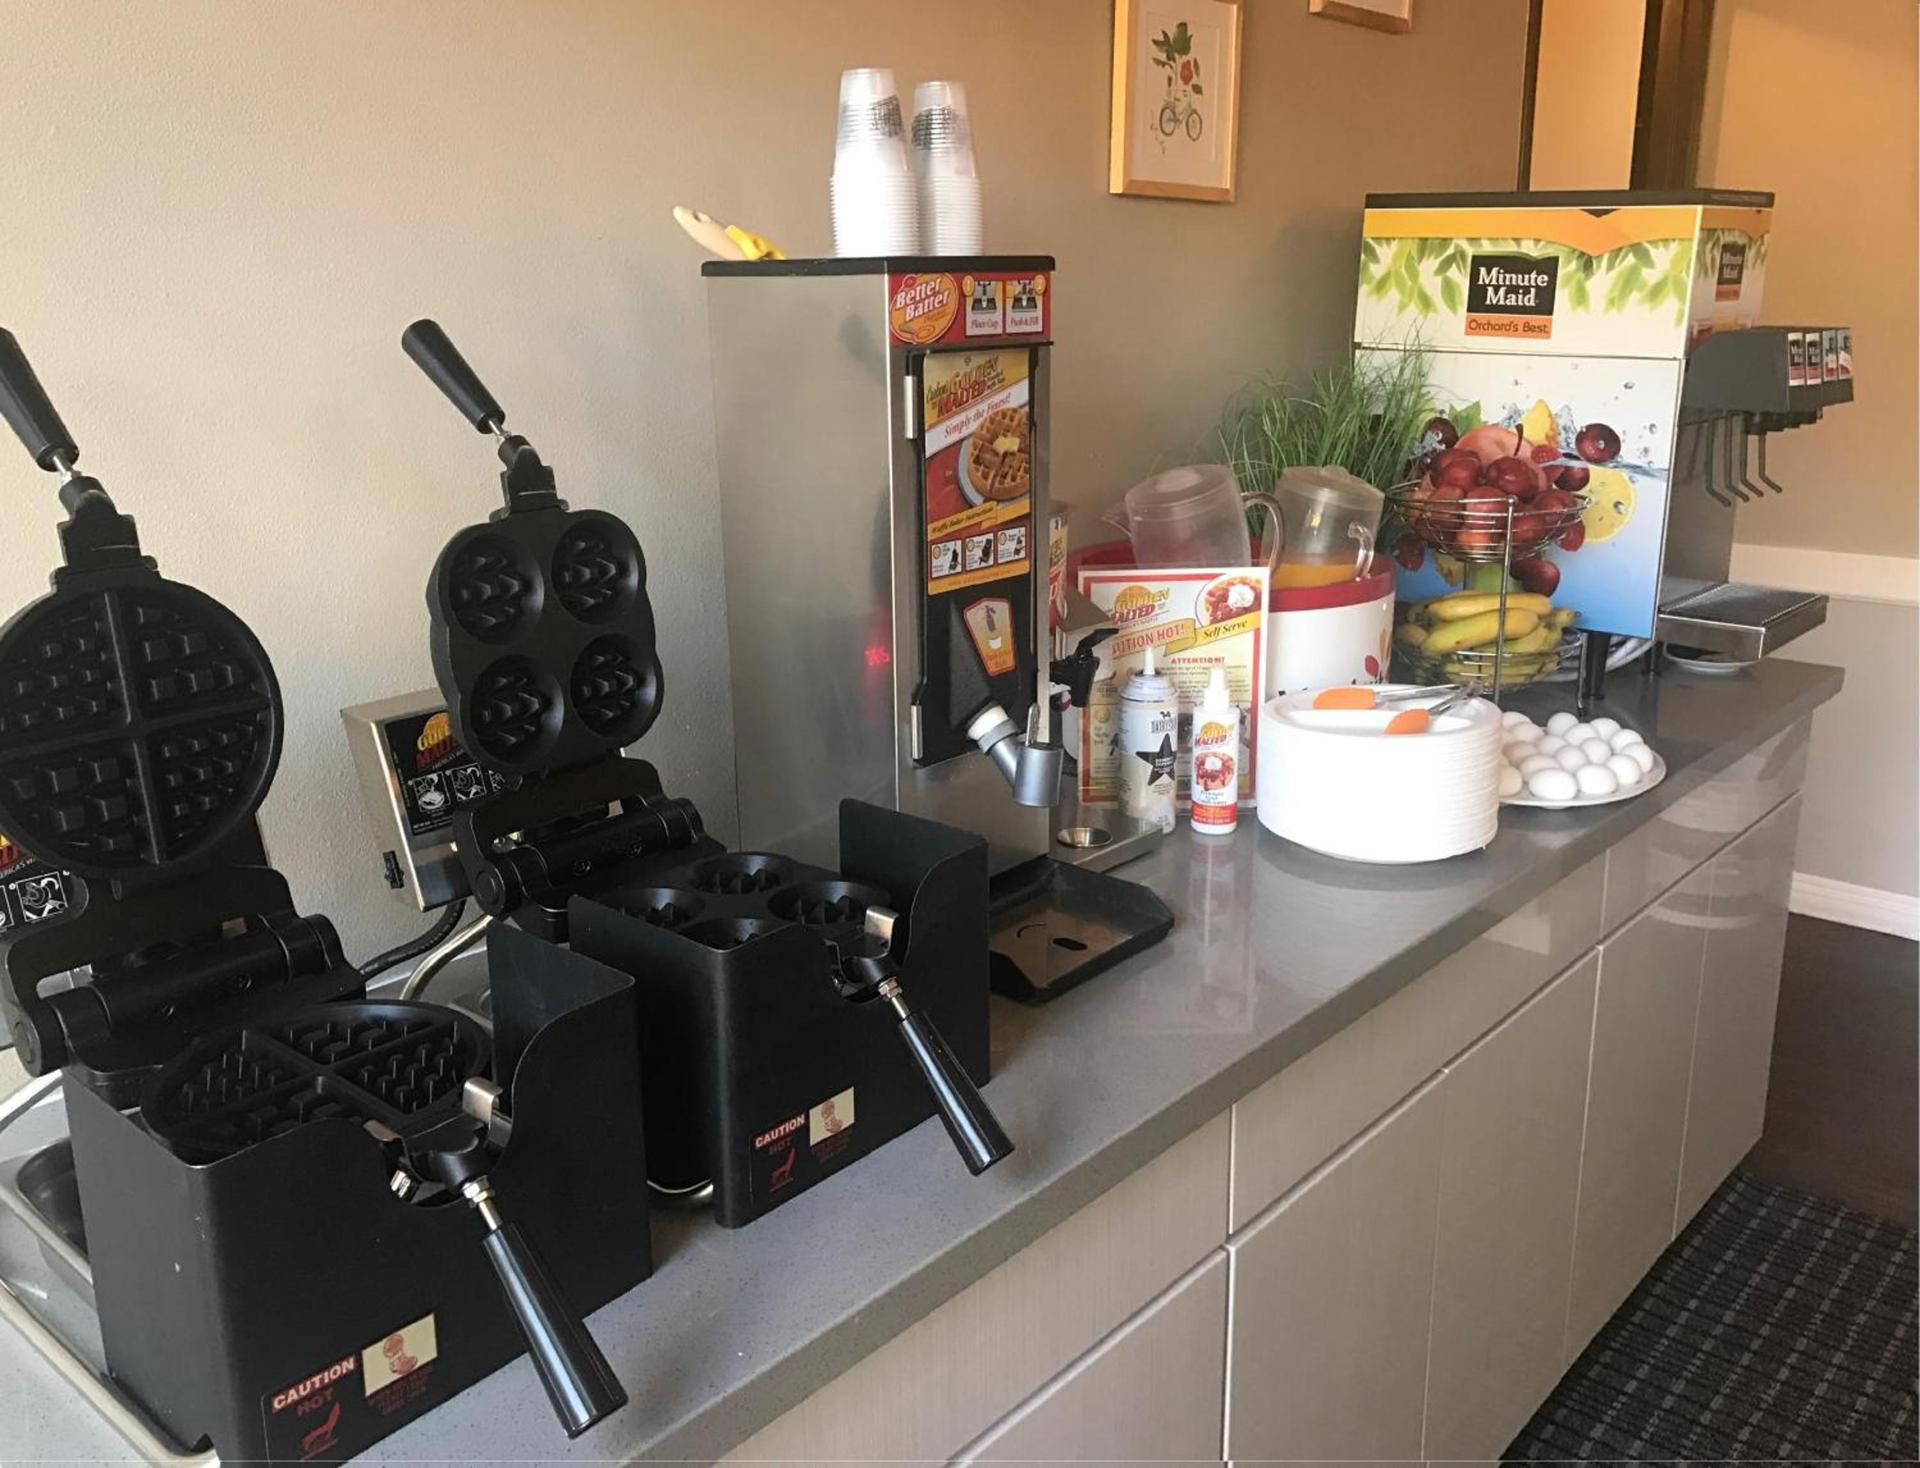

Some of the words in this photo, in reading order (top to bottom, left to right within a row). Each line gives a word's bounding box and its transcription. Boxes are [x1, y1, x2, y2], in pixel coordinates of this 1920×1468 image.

[1477, 266, 1549, 287] Minute
[895, 277, 941, 310] Better
[1484, 286, 1537, 307] Maid
[905, 290, 950, 321] Batter
[1468, 319, 1519, 332] Orchard's
[1522, 321, 1549, 334] Best
[944, 414, 970, 439] Simply
[972, 408, 985, 422] the
[1157, 623, 1184, 641] HOT!
[1202, 626, 1221, 639] Self
[1222, 620, 1248, 634] Serve
[1170, 656, 1225, 665] ATTENTION!
[755, 1113, 805, 1148] CAUTION
[272, 1354, 355, 1410] CAUTION
